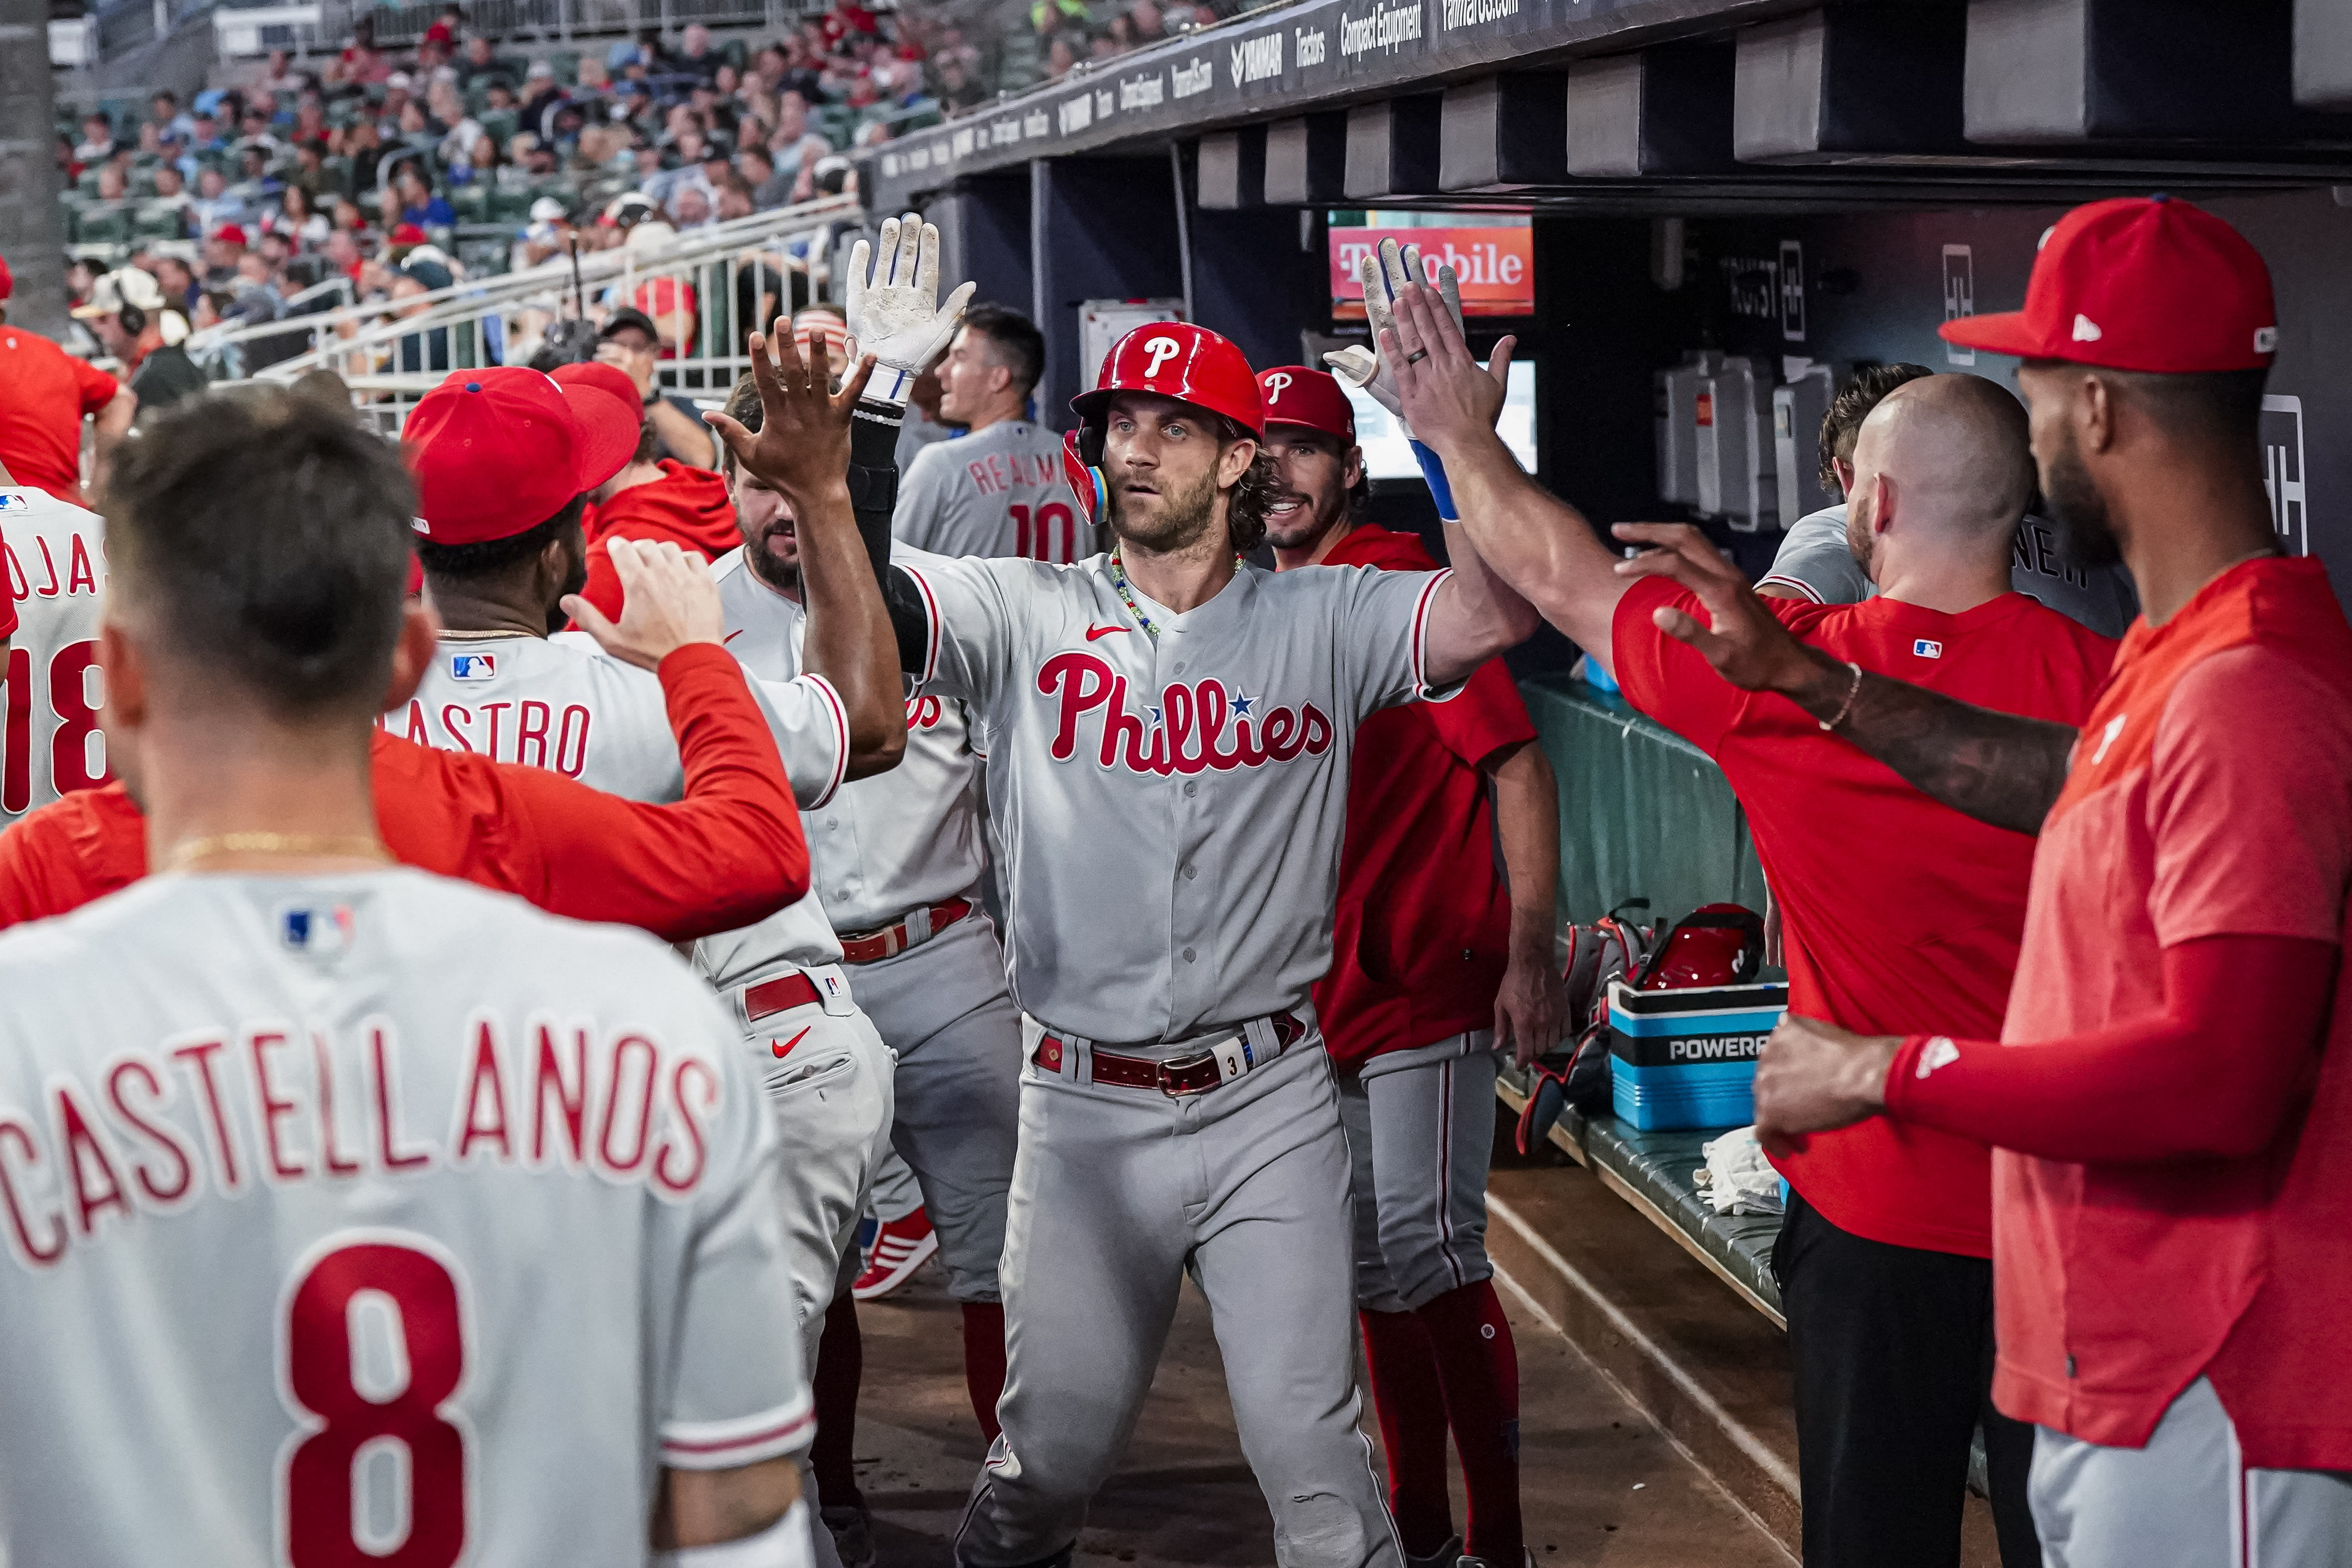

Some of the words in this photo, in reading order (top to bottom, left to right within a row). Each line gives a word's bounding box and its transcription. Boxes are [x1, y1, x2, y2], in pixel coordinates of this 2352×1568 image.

[1341, 6, 1376, 62] Compact
[1377, 0, 1421, 56] Equipment
[1144, 336, 1180, 378] P
[1264, 372, 1292, 405] P
[967, 452, 1069, 496] REALM
[1008, 501, 1074, 565] 10
[1, 638, 114, 814] 18
[374, 698, 591, 781] ASTRO
[1037, 650, 1334, 778] Phillies
[1227, 1055, 1238, 1076] 3
[0, 1012, 722, 1270] CASTELLANOS
[280, 1232, 472, 1568] 8
